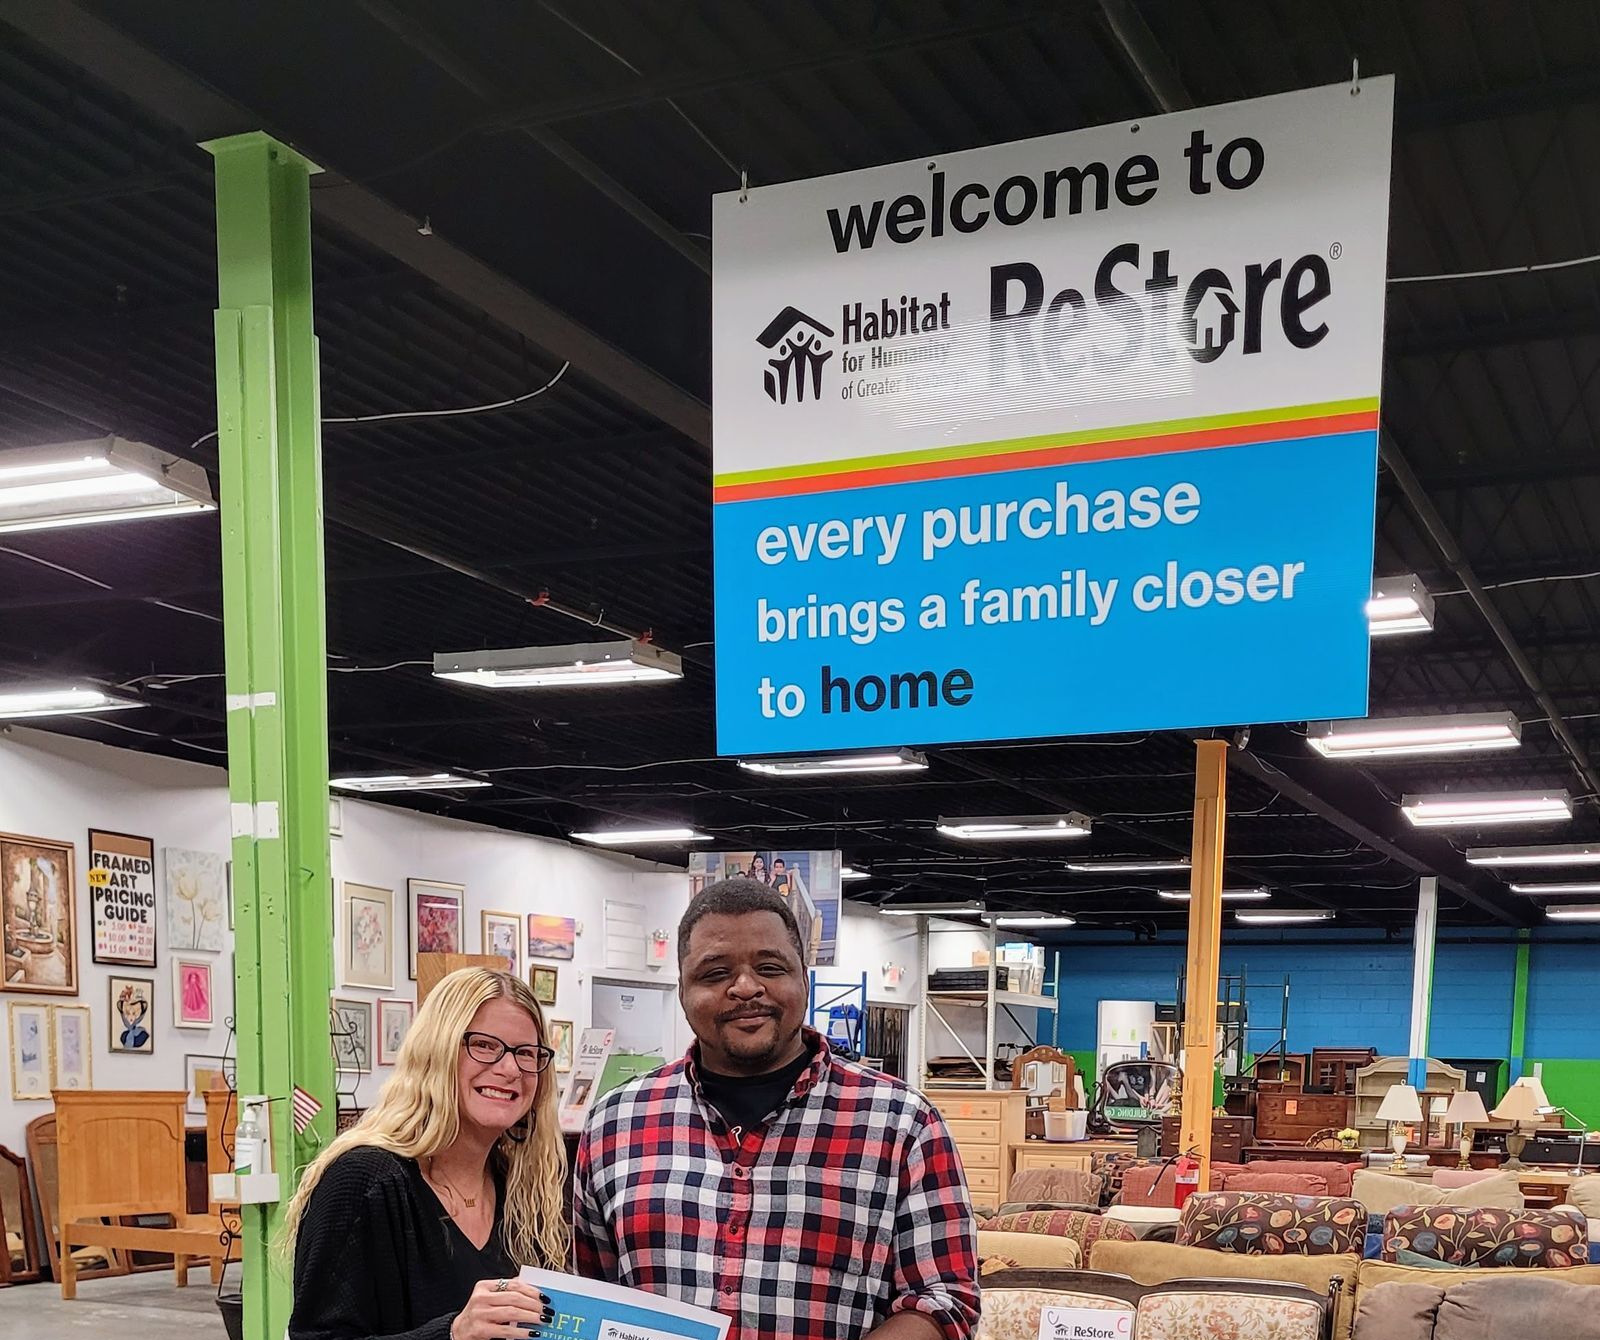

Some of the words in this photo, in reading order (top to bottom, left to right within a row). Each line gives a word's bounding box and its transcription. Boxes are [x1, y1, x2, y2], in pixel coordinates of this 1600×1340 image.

[826, 152, 1159, 254] welcome
[1184, 130, 1265, 195] to
[842, 292, 951, 345] Habitat
[842, 350, 863, 373] for
[841, 381, 853, 400] of
[857, 376, 900, 398] Greater
[756, 512, 905, 565] every
[922, 481, 1201, 560] purchase
[758, 595, 905, 645] brings
[918, 595, 947, 629] a
[961, 569, 1118, 625] family
[1132, 560, 1304, 612] closer
[758, 677, 806, 718] to
[821, 665, 974, 714] home
[94, 853, 151, 875] FRAMED
[90, 873, 107, 882] NEW
[109, 873, 137, 889] ART
[95, 887, 154, 908] PRICING
[104, 905, 148, 924] GUIDE
[547, 1313, 586, 1334] IFT
[1074, 1325, 1114, 1339] ReStore
